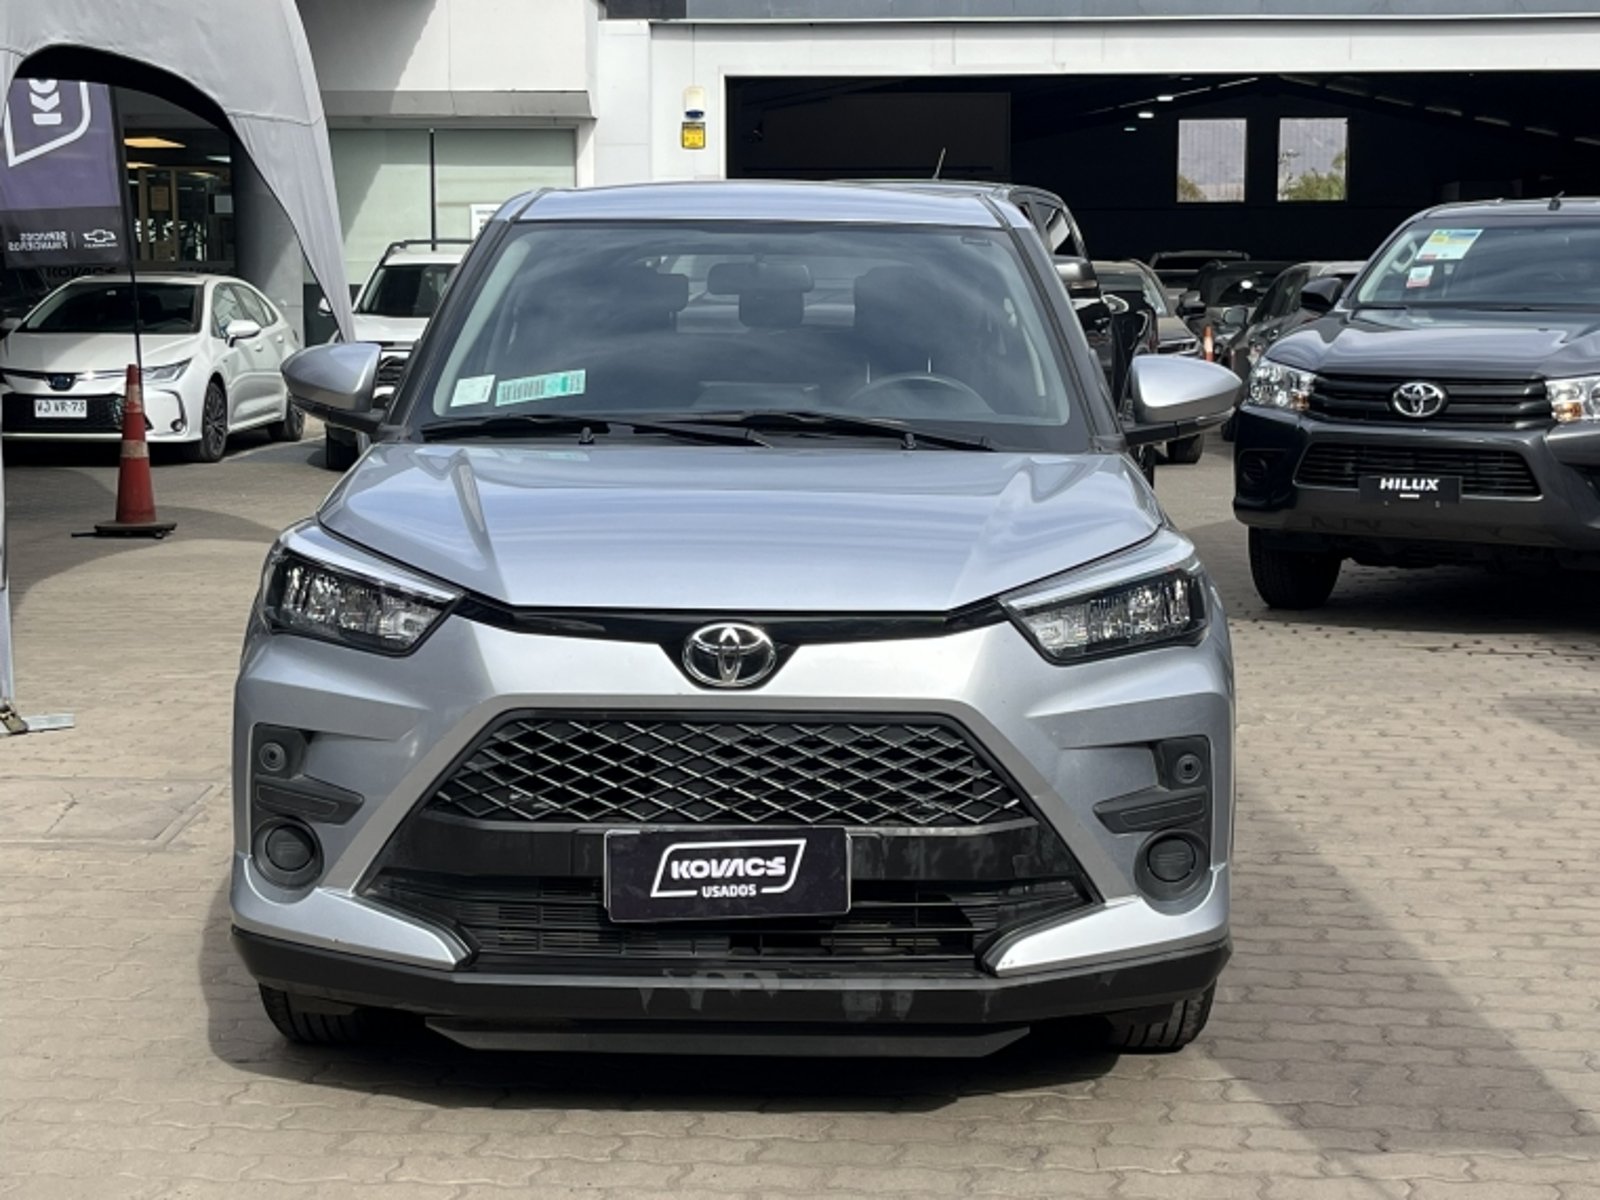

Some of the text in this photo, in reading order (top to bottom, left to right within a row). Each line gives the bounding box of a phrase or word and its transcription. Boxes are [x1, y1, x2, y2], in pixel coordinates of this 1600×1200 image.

[1380, 477, 1440, 491] HILUX
[670, 856, 786, 880] KOVACS
[701, 883, 757, 899] USADOS
